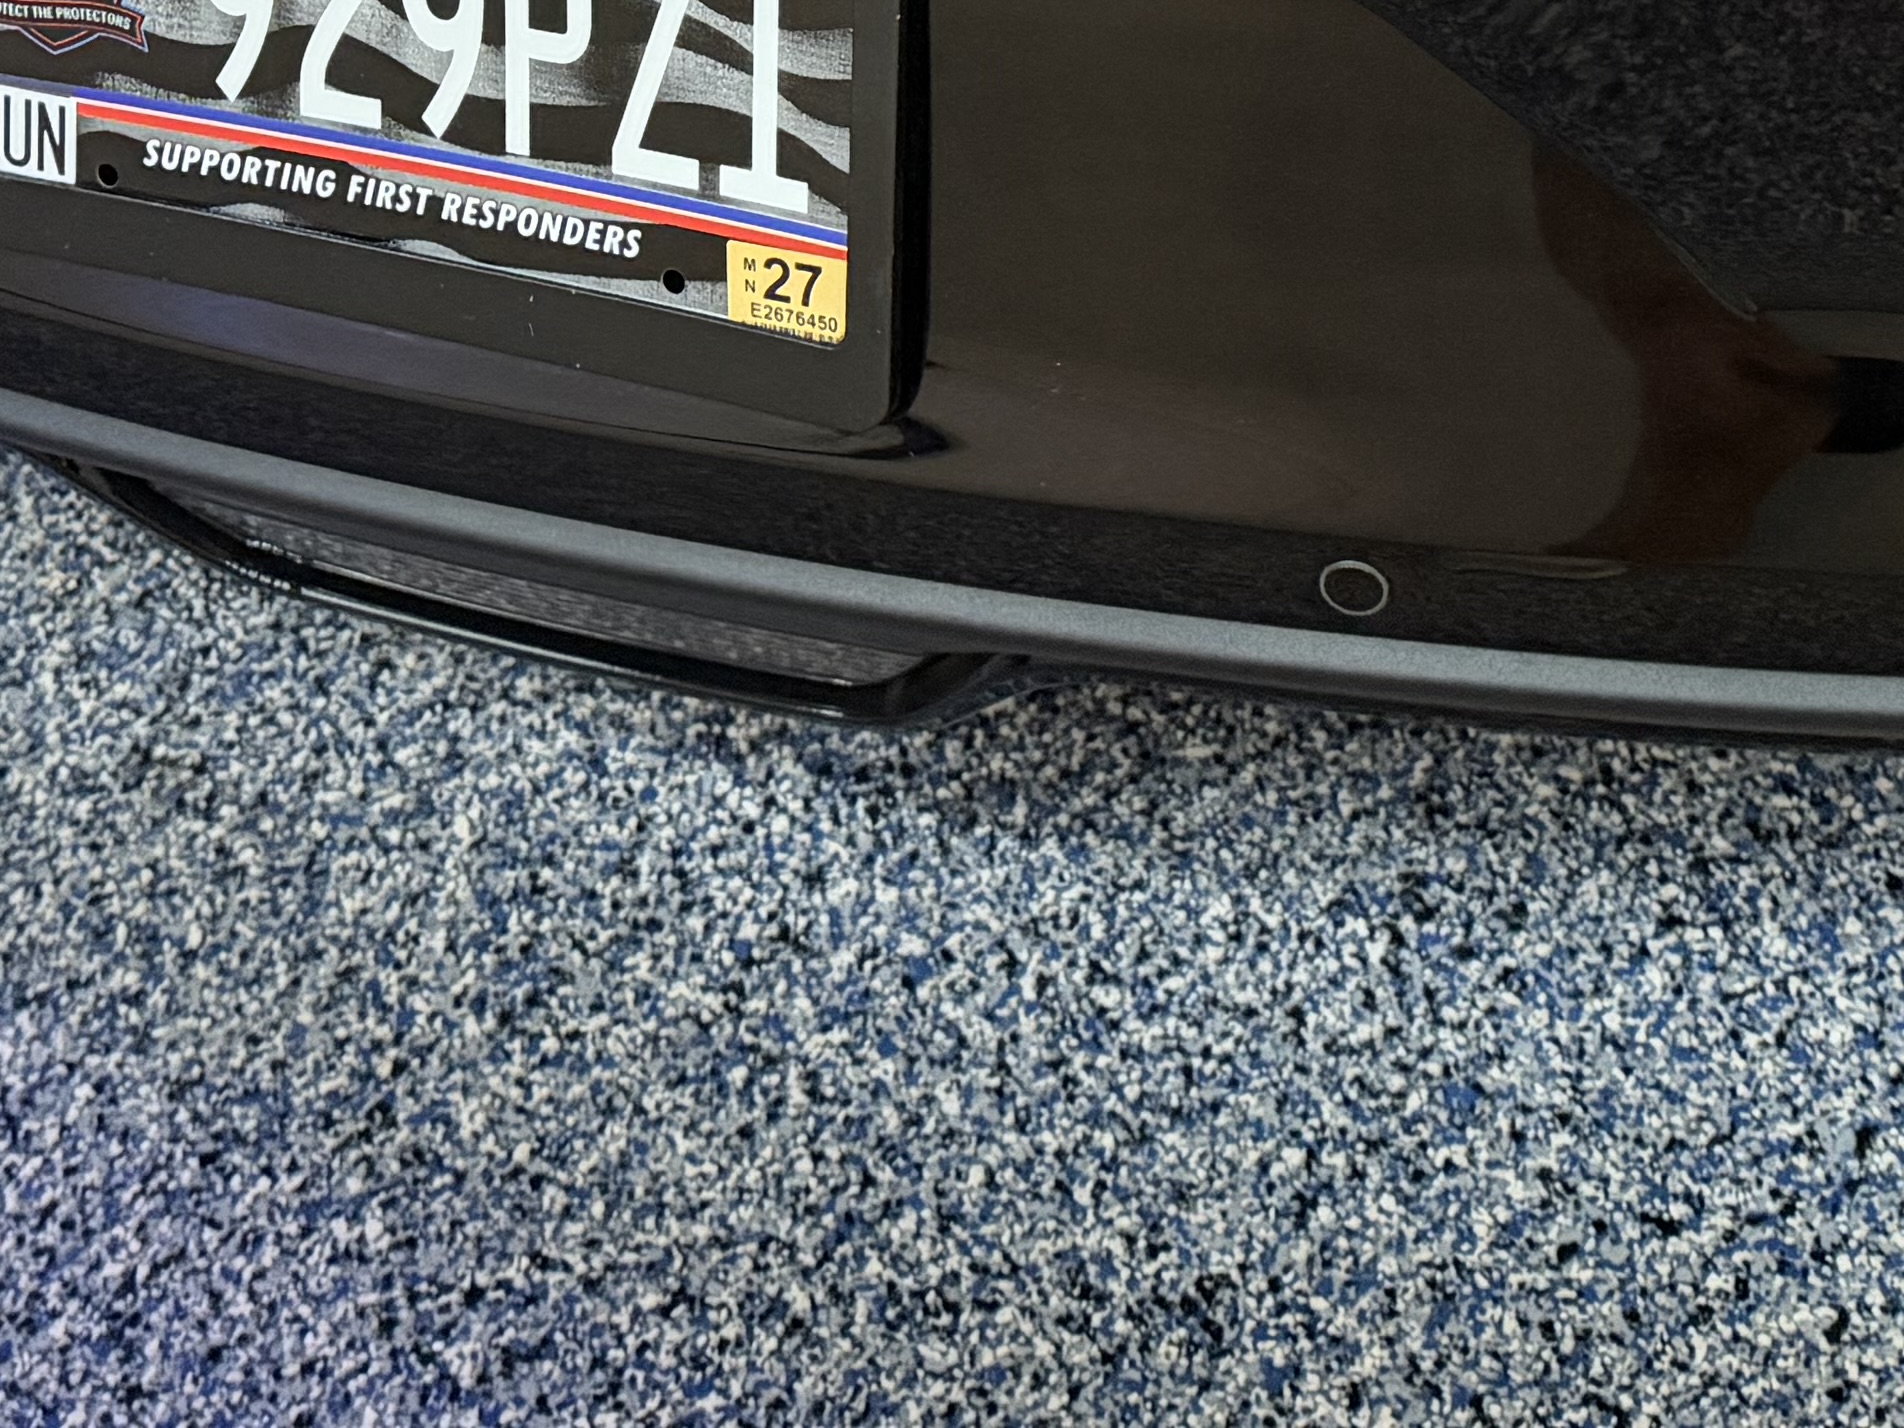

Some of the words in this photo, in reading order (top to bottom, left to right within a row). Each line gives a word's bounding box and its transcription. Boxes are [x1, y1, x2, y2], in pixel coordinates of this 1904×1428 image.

[31, 5, 54, 20] THE
[55, 6, 132, 31] PROTECTORS
[142, 138, 336, 199] SUPPORTING
[347, 173, 435, 218] FIRST
[442, 194, 642, 259] RESPONDERS
[763, 256, 823, 308] 27
[750, 301, 839, 334] E2676450
